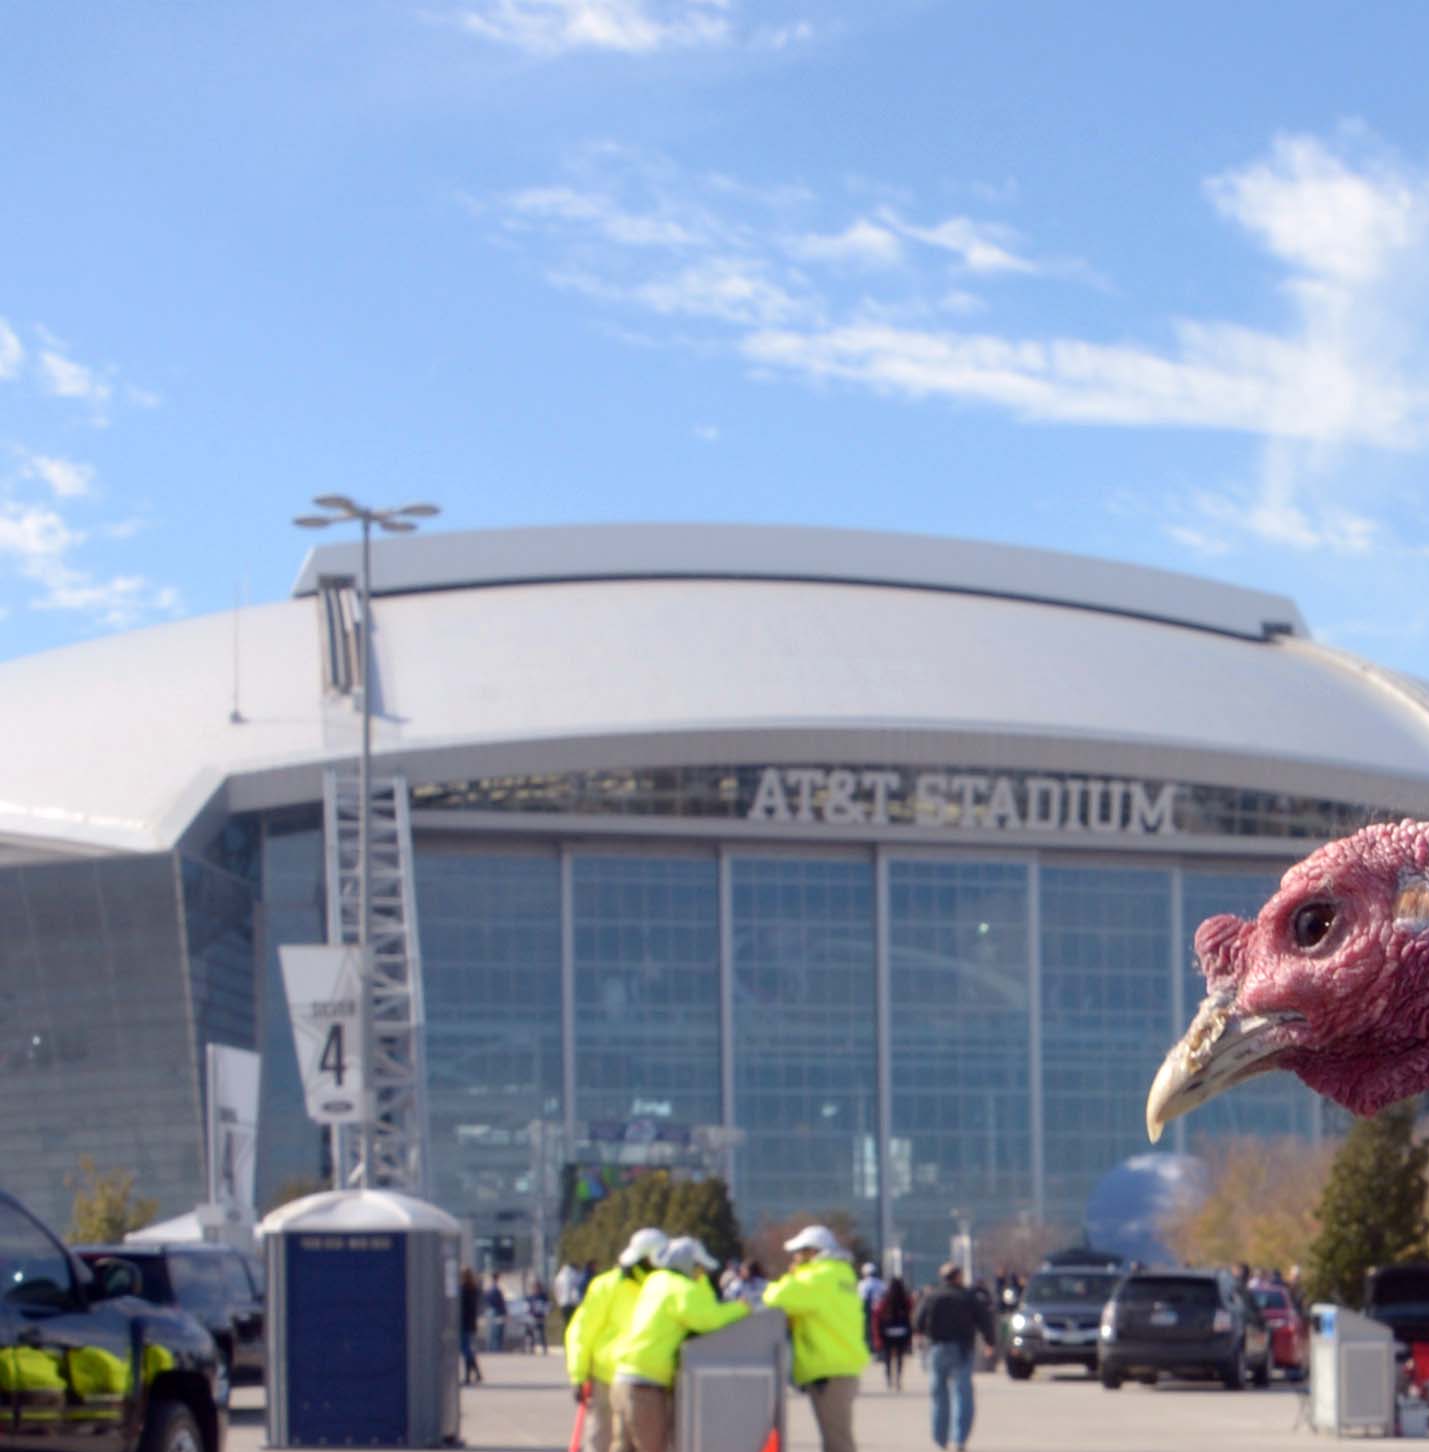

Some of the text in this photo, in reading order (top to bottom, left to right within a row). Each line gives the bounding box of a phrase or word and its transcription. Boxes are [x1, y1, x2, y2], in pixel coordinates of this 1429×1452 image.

[747, 766, 1178, 836] AT&T STADIUM
[319, 1022, 346, 1087] 4
